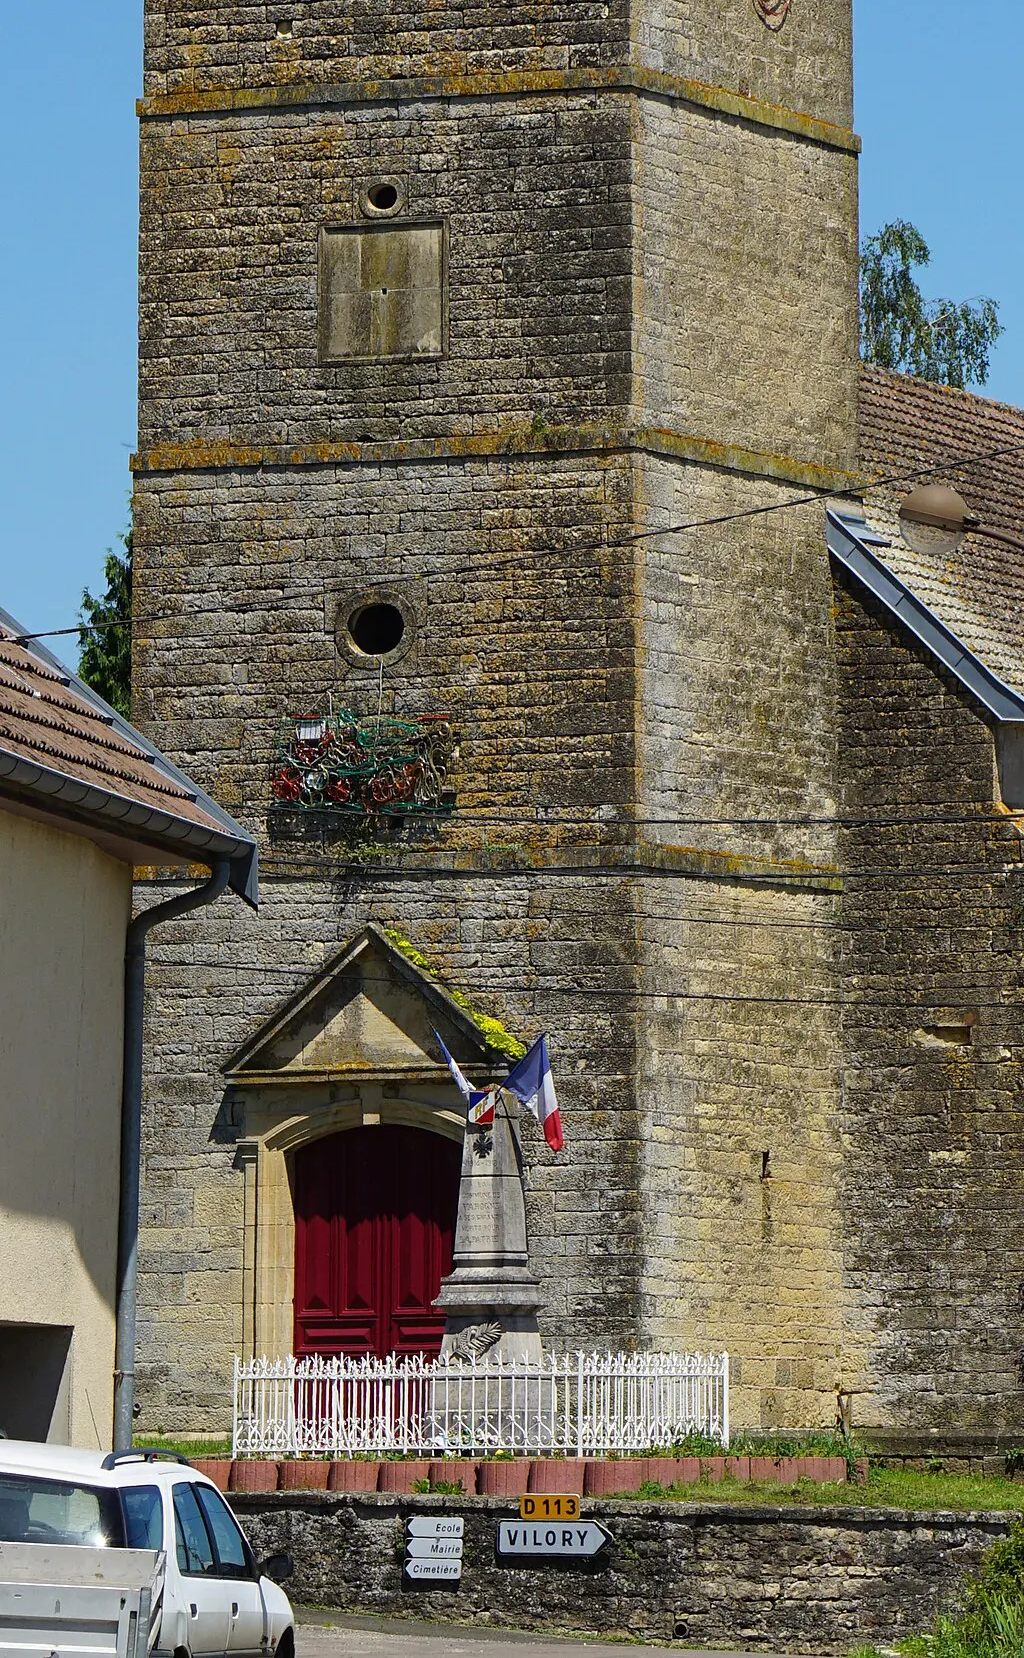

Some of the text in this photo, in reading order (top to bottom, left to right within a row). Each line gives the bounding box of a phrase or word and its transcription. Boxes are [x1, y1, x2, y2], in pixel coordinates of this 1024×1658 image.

[524, 1498, 577, 1515] D 113
[435, 1523, 461, 1533] Ecole
[507, 1529, 589, 1547] VILORY
[430, 1544, 461, 1554] Mairie
[413, 1564, 458, 1574] Cimetière
